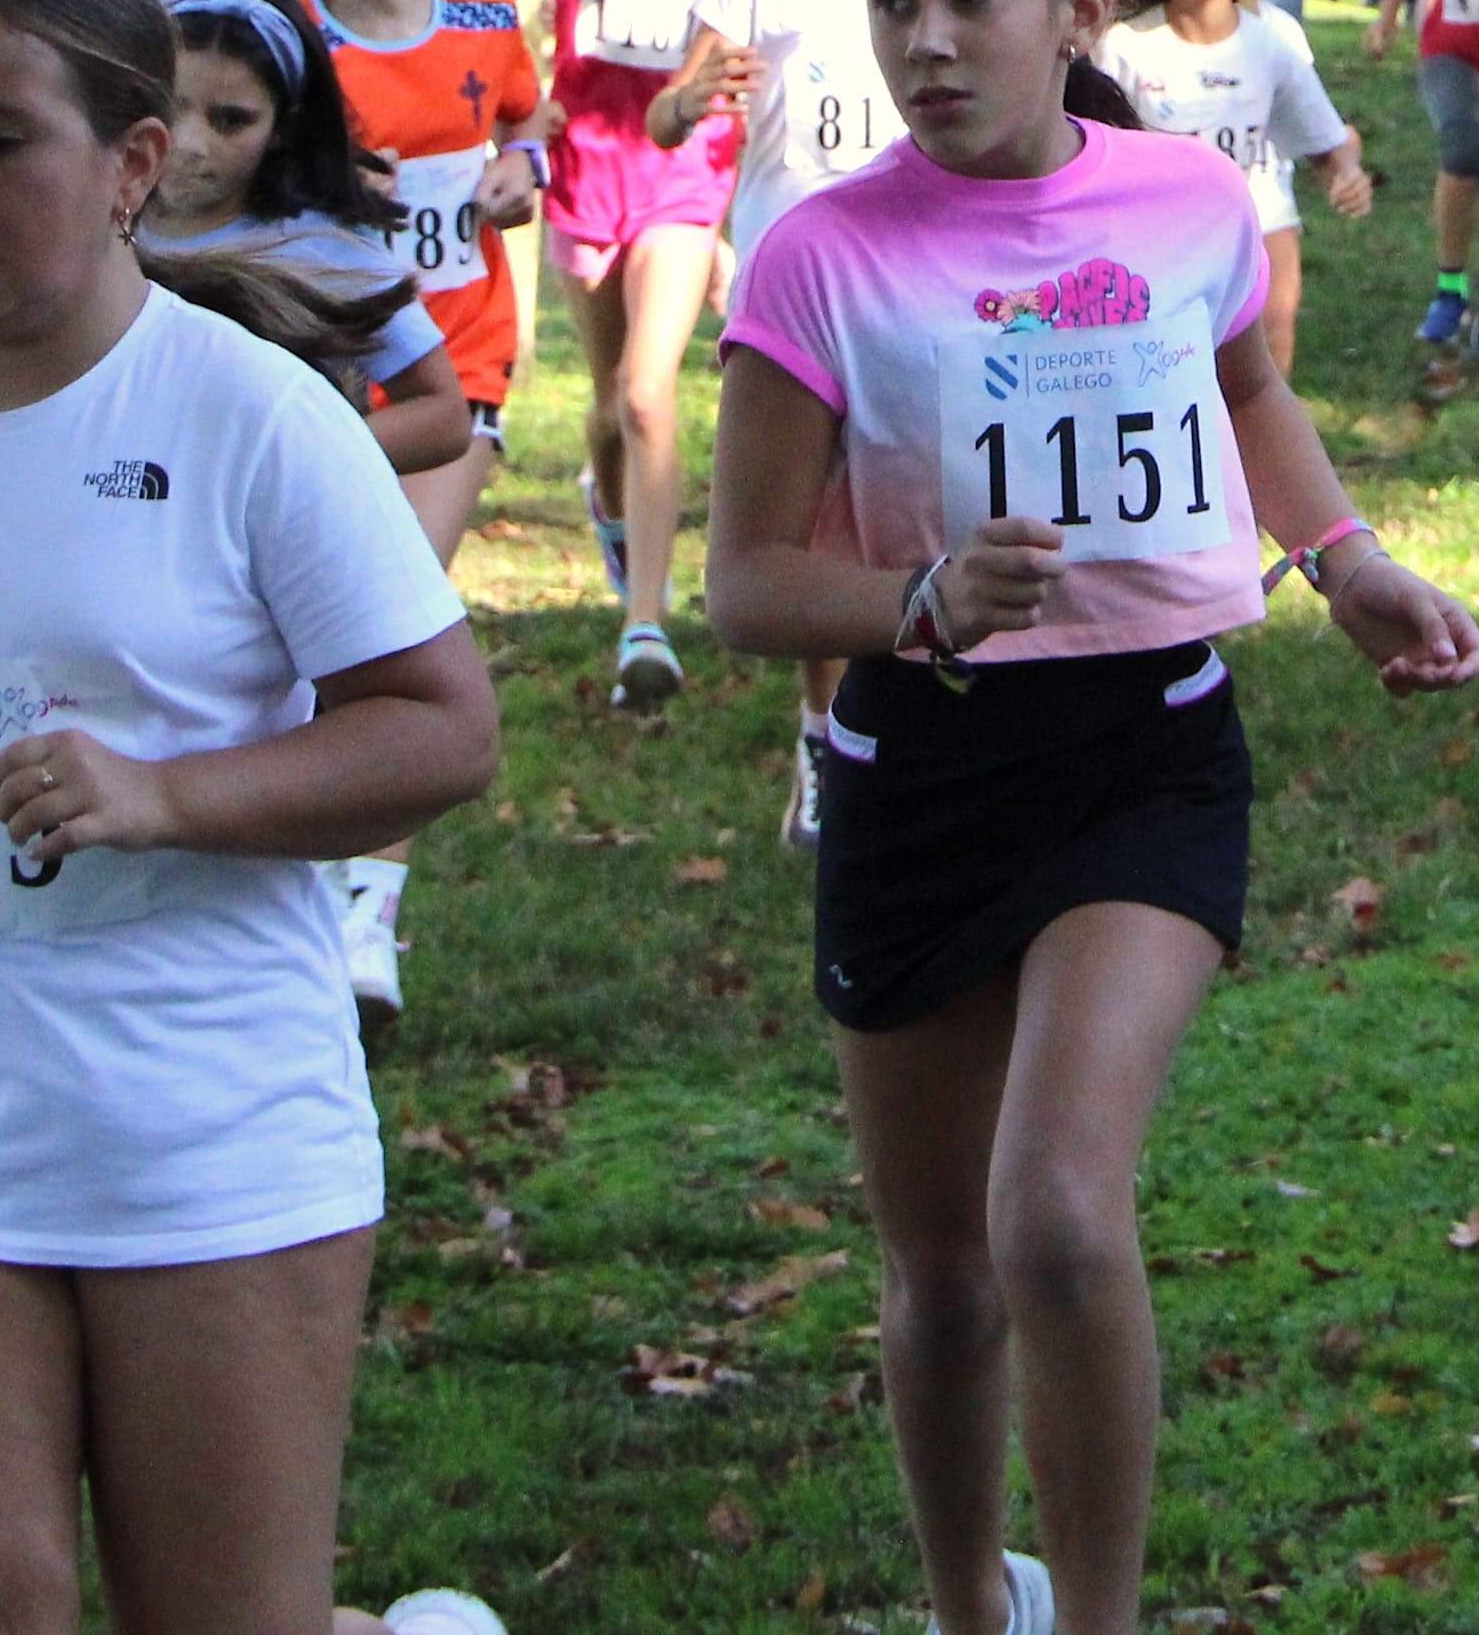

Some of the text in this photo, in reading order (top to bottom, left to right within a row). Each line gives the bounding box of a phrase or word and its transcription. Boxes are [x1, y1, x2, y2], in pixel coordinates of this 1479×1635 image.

[1034, 349, 1118, 371] DEPORTE
[1035, 372, 1113, 394] GALEGO
[114, 460, 143, 475] THE
[974, 402, 1210, 525] 1151
[83, 472, 141, 486] NORTH
[97, 485, 138, 499] FACE
